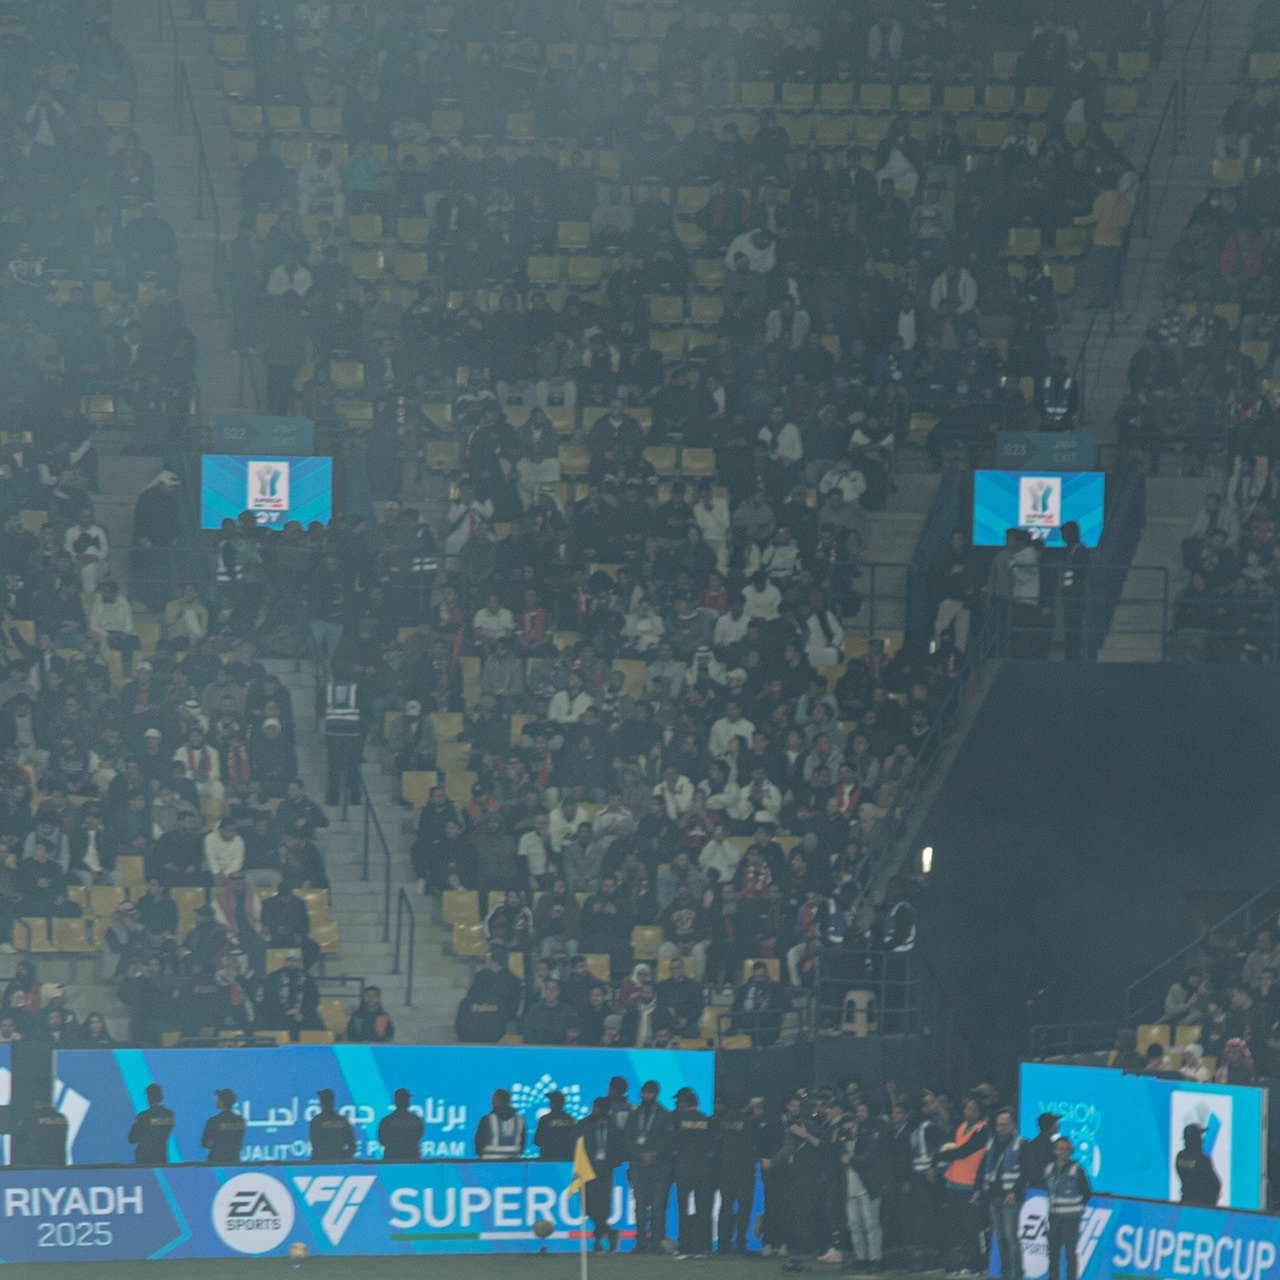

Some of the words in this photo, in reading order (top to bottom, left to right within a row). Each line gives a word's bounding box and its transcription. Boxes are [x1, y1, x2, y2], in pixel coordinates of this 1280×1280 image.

[4, 1185, 144, 1218] RIYADH
[227, 1190, 280, 1216] EA
[37, 1221, 113, 1247] 2025
[225, 1217, 281, 1232] SPORTS
